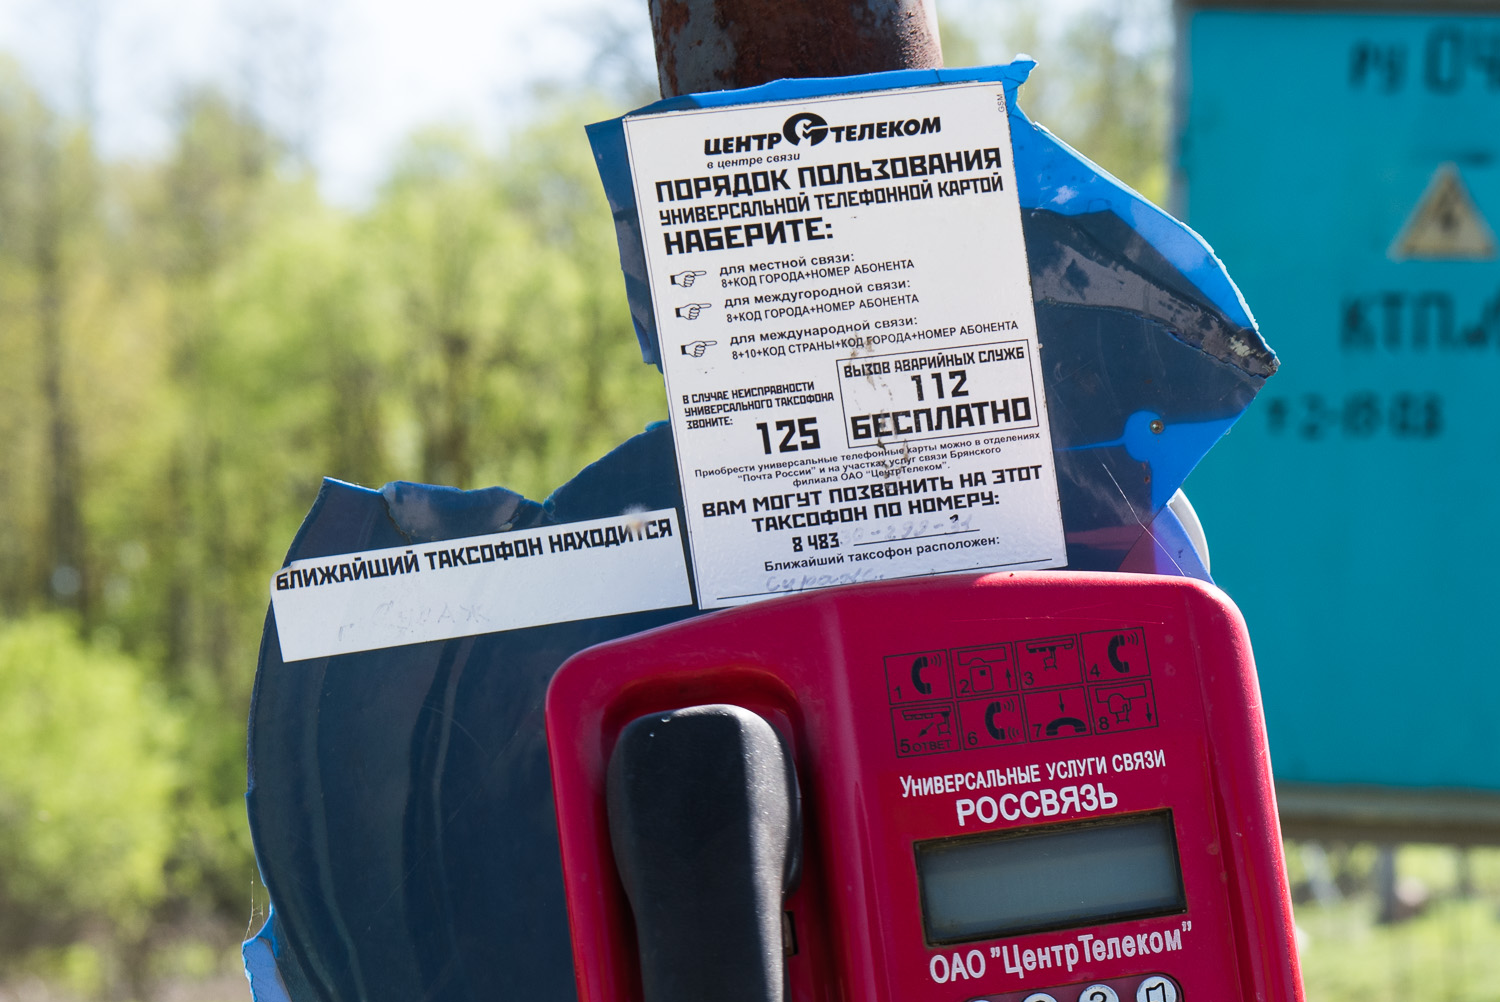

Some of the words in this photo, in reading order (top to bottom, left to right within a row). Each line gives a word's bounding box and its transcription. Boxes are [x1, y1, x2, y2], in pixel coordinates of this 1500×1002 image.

[997, 94, 1005, 113] GSM
[704, 132, 782, 155] ЦЕНТР
[830, 116, 942, 143] ТЕЛЕКОМ
[655, 168, 791, 203] ПОРЯДОК
[797, 147, 1002, 189] ПОЛЬЗОВАНИЯ
[706, 161, 714, 169] в
[717, 155, 764, 170] центре
[766, 152, 801, 164] связи
[659, 191, 811, 227] УНИВЕРСАЛЬНОЙ
[814, 178, 934, 210] ТЕЛЕФОННОЙ
[937, 171, 1004, 197] КАРТОЙ
[663, 216, 834, 256] НАБЕРИТЕ:
[719, 264, 745, 277] для
[749, 256, 807, 272] местной
[811, 252, 855, 266] связи:
[721, 273, 757, 288] 8+КОД
[759, 265, 851, 286] ГОРОДА+НОМЕР
[853, 258, 915, 275] АБОНЕНТА
[724, 296, 750, 309] для
[754, 282, 863, 306] междугородной
[867, 279, 911, 292] связи:
[726, 309, 763, 323] 8+КОД
[764, 300, 856, 320] ГОРОДА+НОМЕР
[858, 293, 920, 310] АБОНЕНТА
[729, 334, 756, 347] для
[759, 320, 870, 342] международной
[874, 316, 918, 329] связи:
[732, 345, 786, 361] 8+10+КОД
[788, 336, 864, 355] СТРАНЫ+КОД
[866, 326, 957, 345] ГОРОДА+НОМЕР
[959, 319, 1019, 337] АБОНЕНТА
[843, 361, 891, 379] ВЫЗОВ
[894, 352, 976, 373] АВАРИЙНЫХ
[978, 346, 1025, 364] СЛУЖБ
[682, 394, 690, 404] В
[691, 390, 730, 404] СЛУЧАЕ
[731, 381, 815, 400] НЕИСПРАВНОСТИ
[910, 369, 969, 402] 112
[684, 399, 773, 417] УНИВЕРСАЛЬНОГО
[775, 391, 835, 407] ТАКСОФОНА
[850, 396, 1032, 441] БЕСПЛАТНО
[686, 416, 734, 430] ЗВОНИТЕ:
[755, 416, 821, 455] 125
[694, 463, 755, 479] Приобрести
[757, 455, 838, 472] универсальные
[840, 446, 905, 462] телефонные
[907, 444, 938, 456] карты
[939, 439, 973, 450] можно
[975, 438, 981, 446] в
[983, 431, 1041, 446] отделениях
[737, 473, 773, 484] "Почта
[775, 466, 817, 480] России"
[828, 466, 840, 474] на
[842, 459, 887, 473] участках
[889, 456, 916, 468] услуг
[918, 452, 948, 462] связи
[950, 446, 1002, 460] Брянского
[702, 499, 747, 518] ВАМ
[752, 490, 823, 512] МОГУТ
[828, 476, 954, 504] ПОЗВОНИТЬ
[959, 471, 987, 489] НА
[991, 464, 1043, 485] ЭТОТ
[792, 476, 839, 488] филиала
[841, 472, 864, 481] ОАО
[751, 505, 868, 533] ТАКСОФОН
[874, 501, 902, 520] ПО
[908, 490, 1000, 515] НОМЕРУ:
[275, 549, 421, 591] БЛИЖАЙШИЙ
[423, 536, 543, 571] ТАКСОФОН
[549, 517, 673, 554] НАХОДИТСЯ
[764, 552, 845, 572] Ближайший
[847, 544, 913, 562] таксофон
[916, 535, 1000, 557] расположен:
[791, 536, 804, 553] 8
[807, 532, 840, 551] 483
[1023, 671, 1035, 687] 3
[1089, 663, 1101, 678] 4
[959, 679, 971, 694] 2
[967, 731, 979, 746] 6
[1032, 723, 1043, 738] 7
[1098, 716, 1110, 731] 8
[912, 739, 953, 753] ОТВЕТ
[899, 764, 1041, 798] УНИВЕРСАЛЬНЫЕ
[1045, 755, 1108, 782] УСЛУГИ
[1111, 748, 1167, 774] СВЯЗИ
[955, 782, 1119, 827] РОССВЯЗЬ
[929, 949, 986, 984] ОАО
